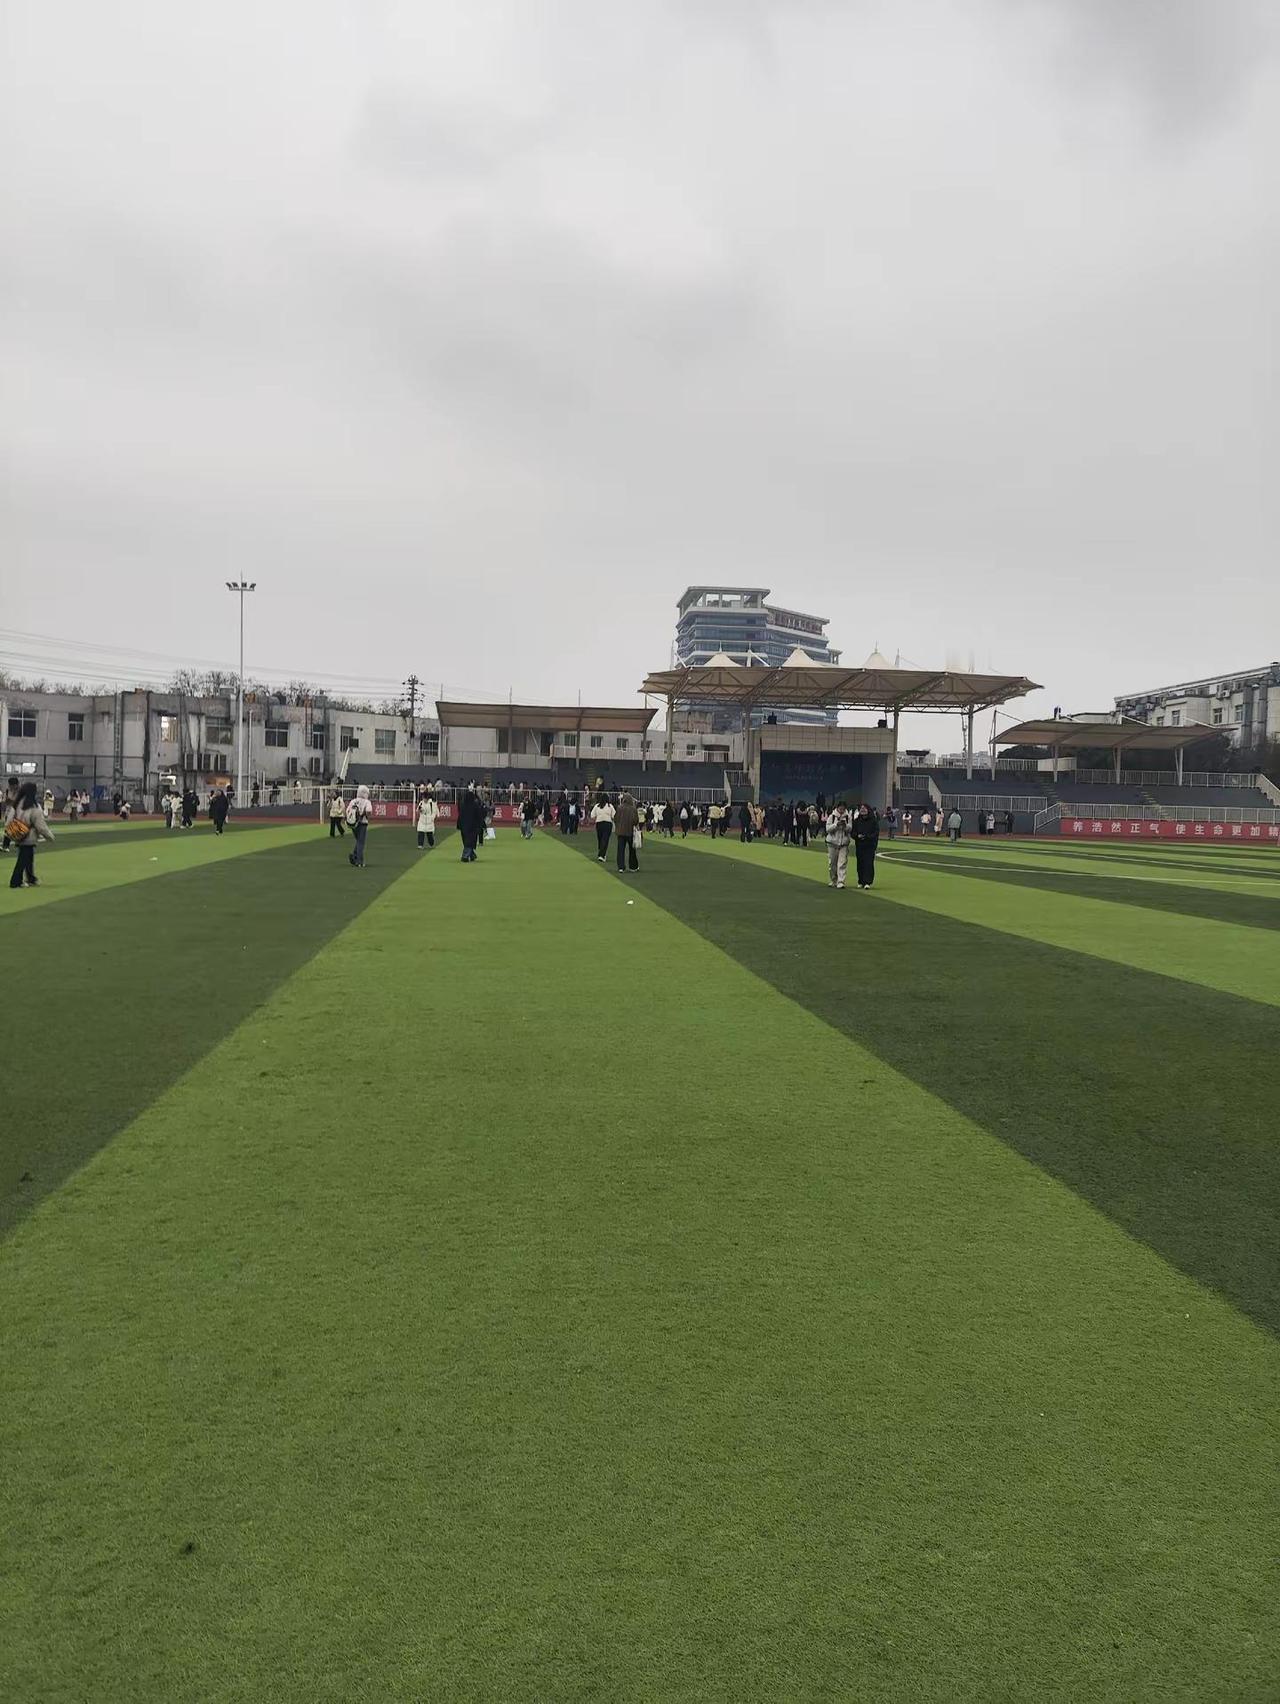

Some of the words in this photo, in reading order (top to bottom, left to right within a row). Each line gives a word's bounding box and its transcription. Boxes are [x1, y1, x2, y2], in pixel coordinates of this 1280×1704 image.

[374, 803, 451, 817] 强健魄
[1073, 821, 1160, 834] 养浩然正气
[1175, 823, 1280, 837] 使生命更加精
